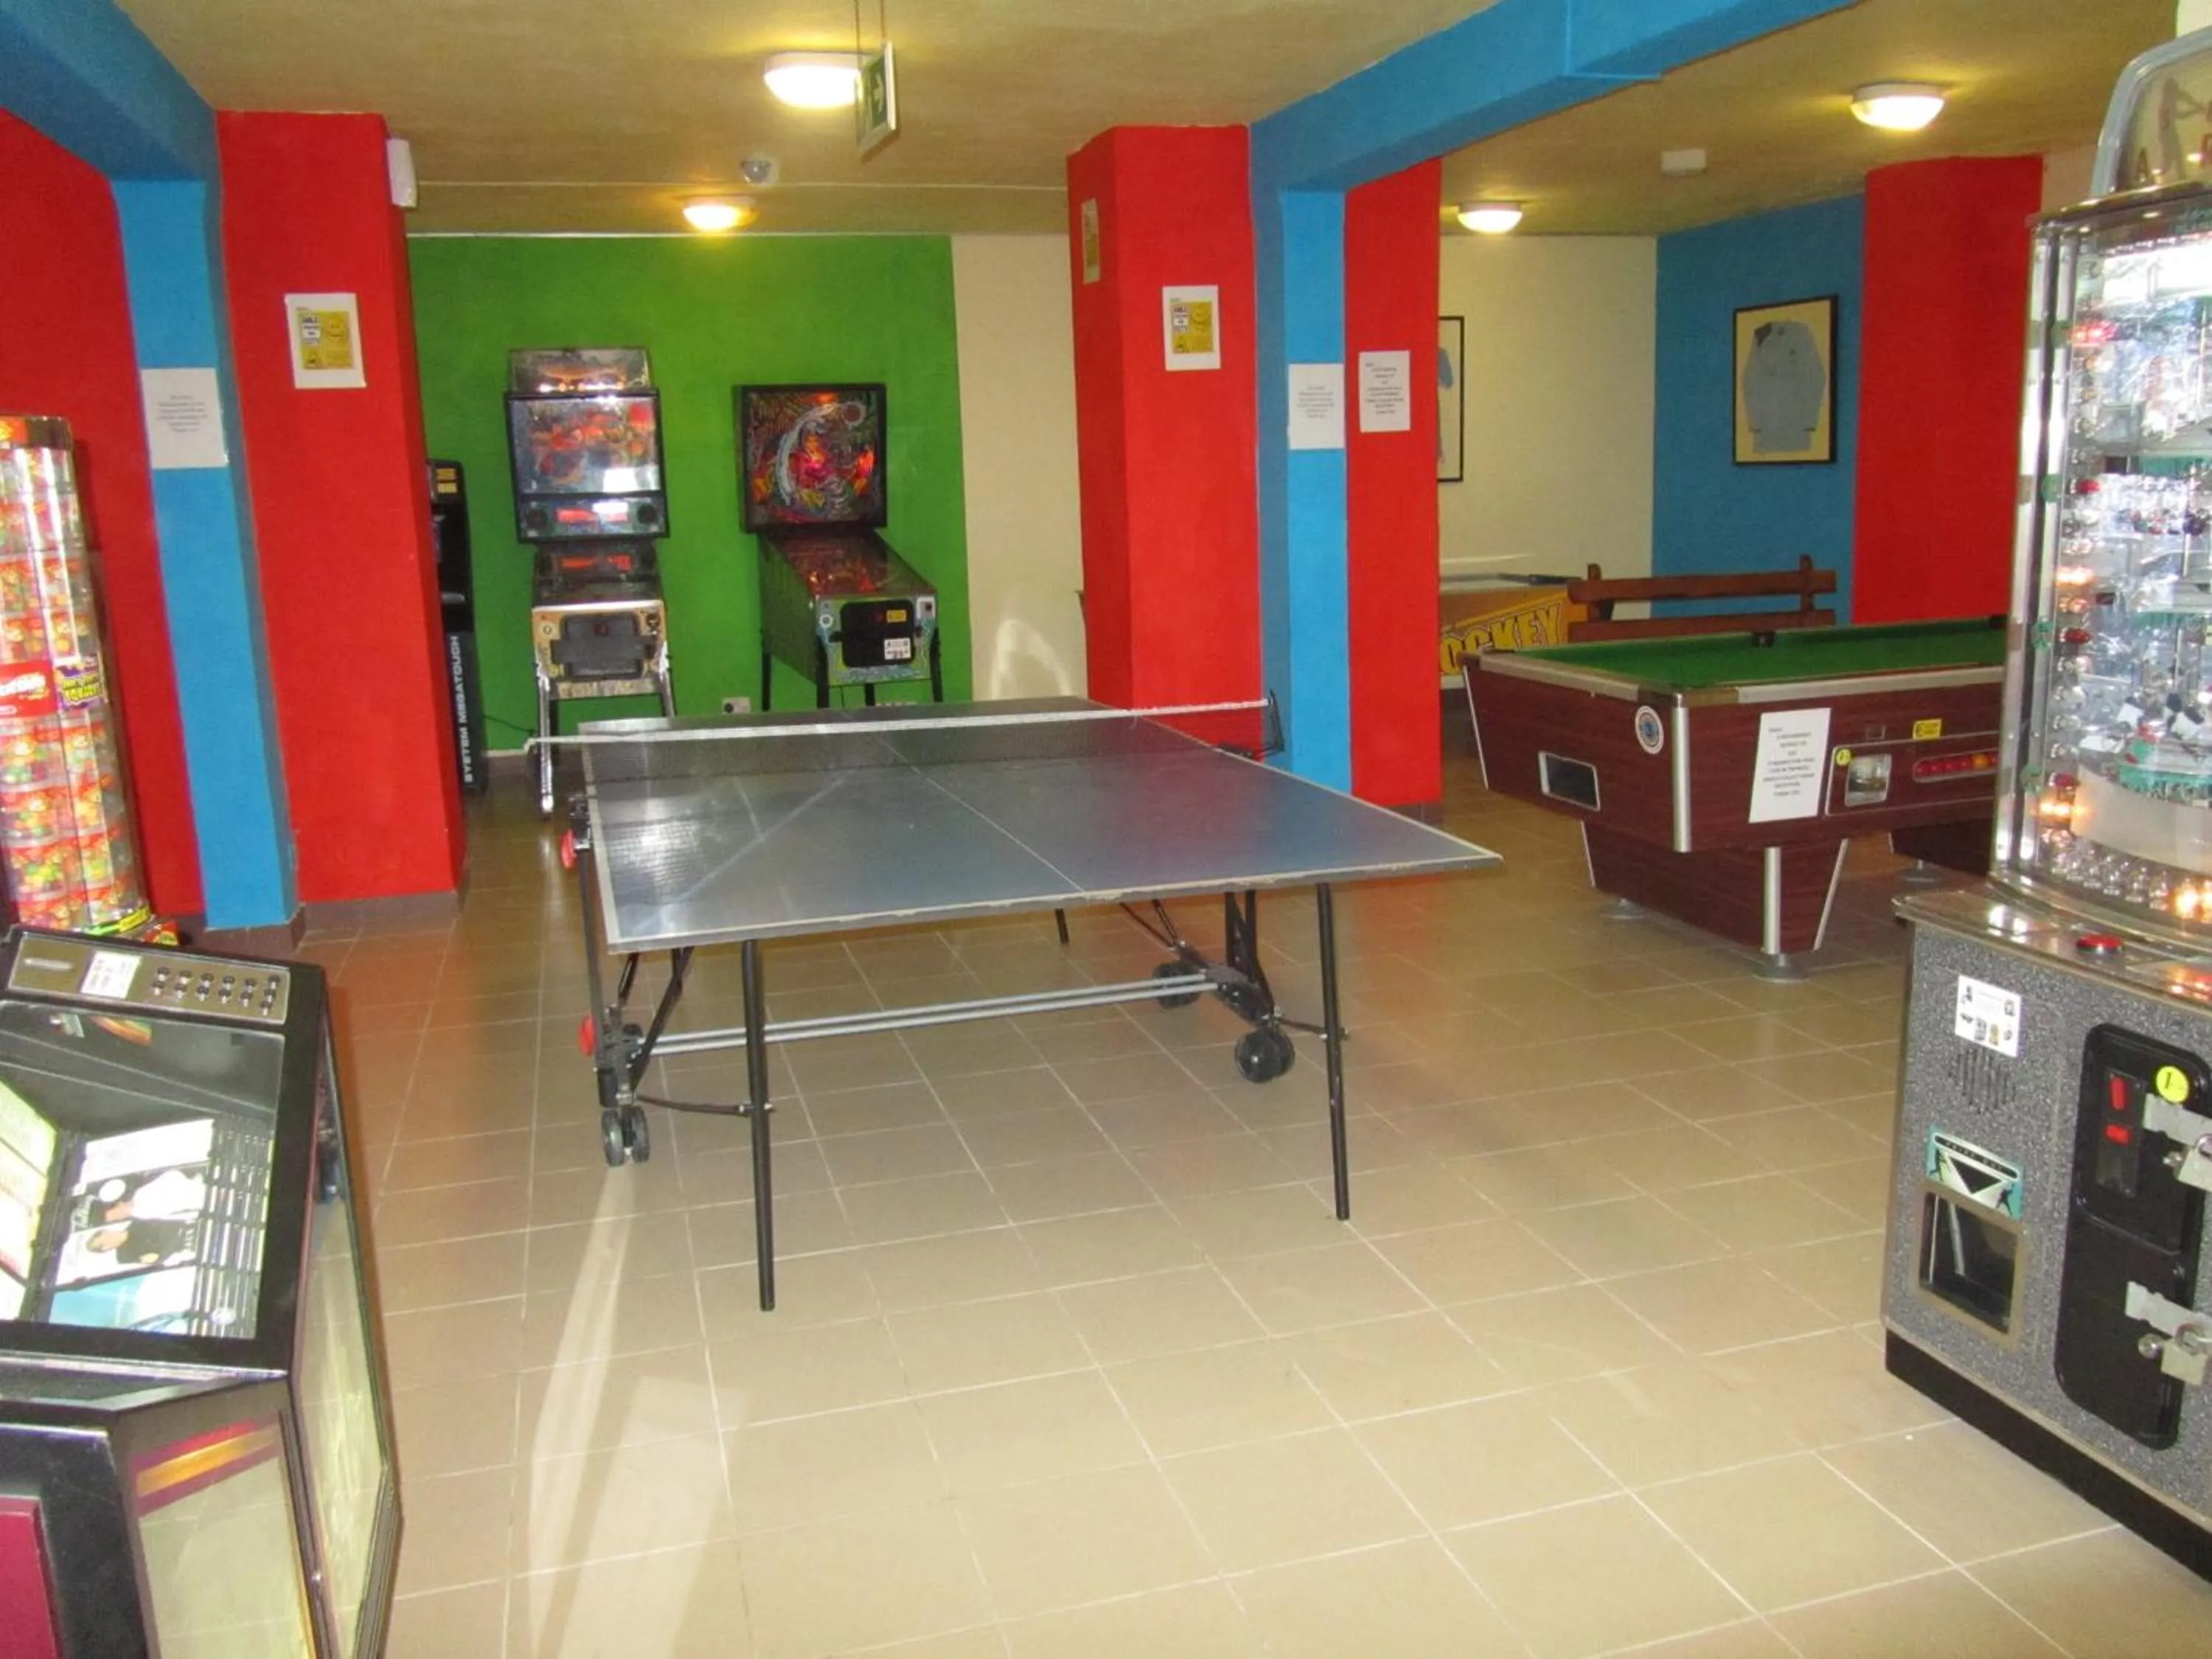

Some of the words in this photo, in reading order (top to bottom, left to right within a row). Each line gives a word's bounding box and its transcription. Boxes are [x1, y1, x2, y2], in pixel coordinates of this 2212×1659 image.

[1440, 602, 1562, 675] OCKEY
[451, 635, 467, 724] MEGATOUCH
[459, 726, 474, 783] SYSTEM
